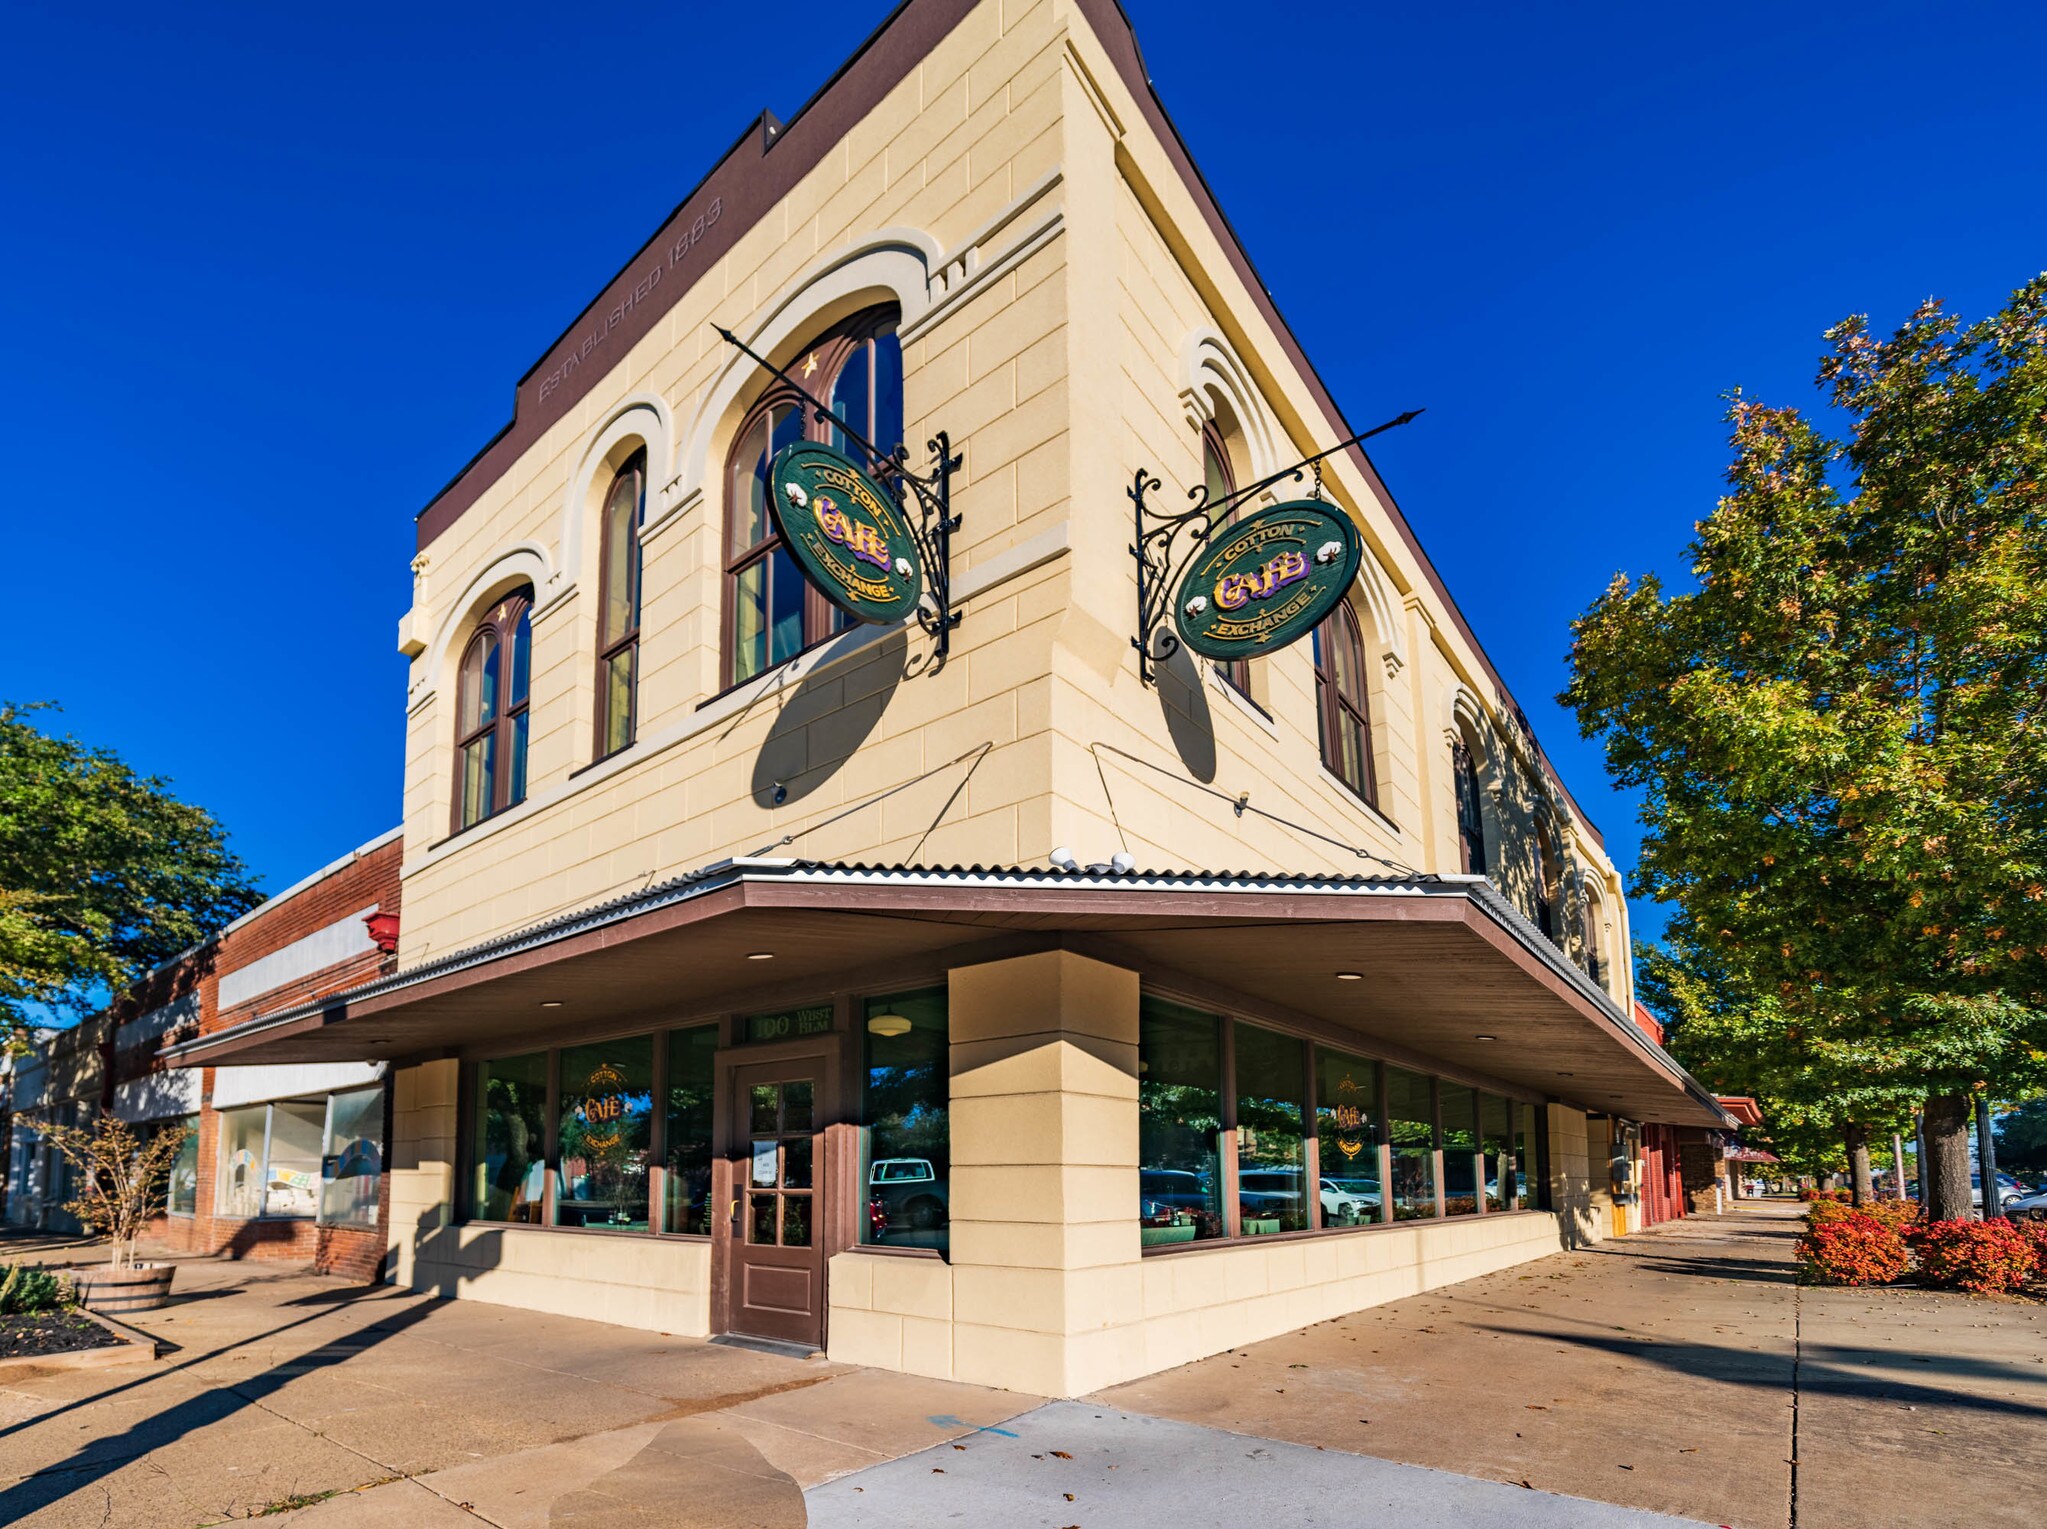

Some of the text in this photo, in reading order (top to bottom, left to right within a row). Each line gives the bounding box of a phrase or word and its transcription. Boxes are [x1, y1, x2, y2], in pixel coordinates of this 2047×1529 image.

[538, 197, 723, 404] ESTABLISHED 1883
[823, 469, 882, 517] COTTON
[1224, 523, 1295, 561] COTTON
[813, 542, 890, 598] EXCHANGE
[1216, 593, 1312, 635] EXCHANGE
[756, 1015, 789, 1039] 100
[590, 1070, 618, 1083] COTTON
[586, 1134, 620, 1148] EXCHANGE
